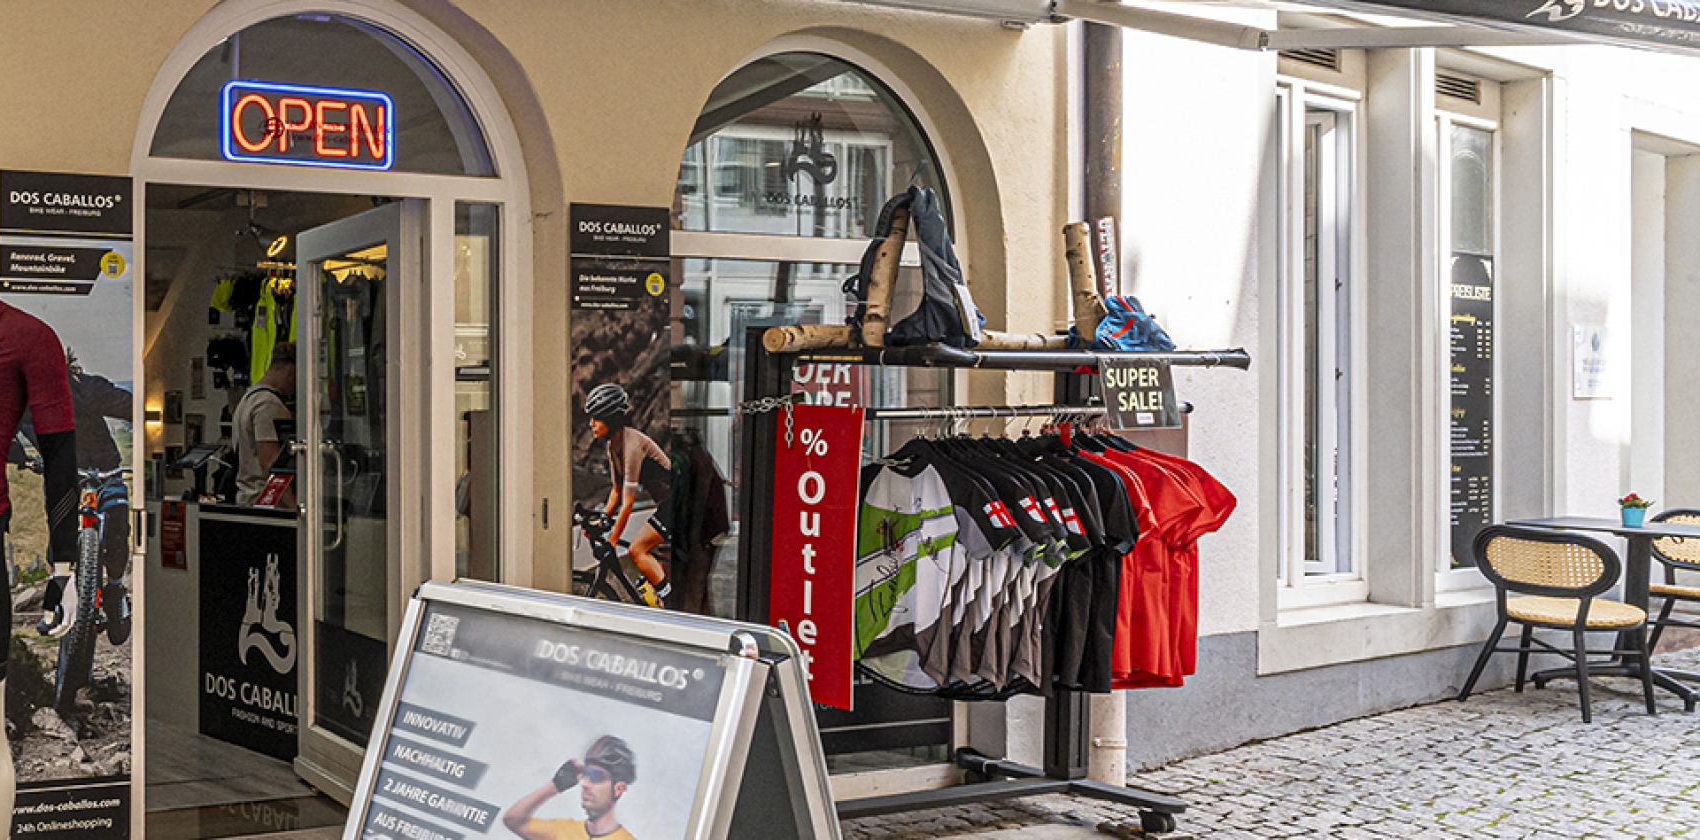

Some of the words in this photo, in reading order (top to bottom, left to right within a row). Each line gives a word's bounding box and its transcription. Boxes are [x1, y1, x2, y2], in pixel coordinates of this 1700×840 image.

[232, 93, 385, 161] OPEN
[10, 190, 40, 205] DOS
[579, 220, 601, 233] DOS
[1106, 367, 1159, 389] SUPER
[1118, 391, 1164, 412] SALE!
[801, 428, 828, 456] %
[798, 470, 826, 682] Outlet
[535, 639, 581, 666] DOS
[205, 672, 236, 700] DOS
[403, 710, 468, 740] INNOVATIV
[393, 743, 467, 779] NACHHALTIG
[383, 777, 395, 792] 2
[392, 781, 430, 805] JAHRE
[428, 792, 490, 825] GARANTIE
[36, 817, 113, 832] Onlineshopping
[374, 811, 399, 831] AUS
